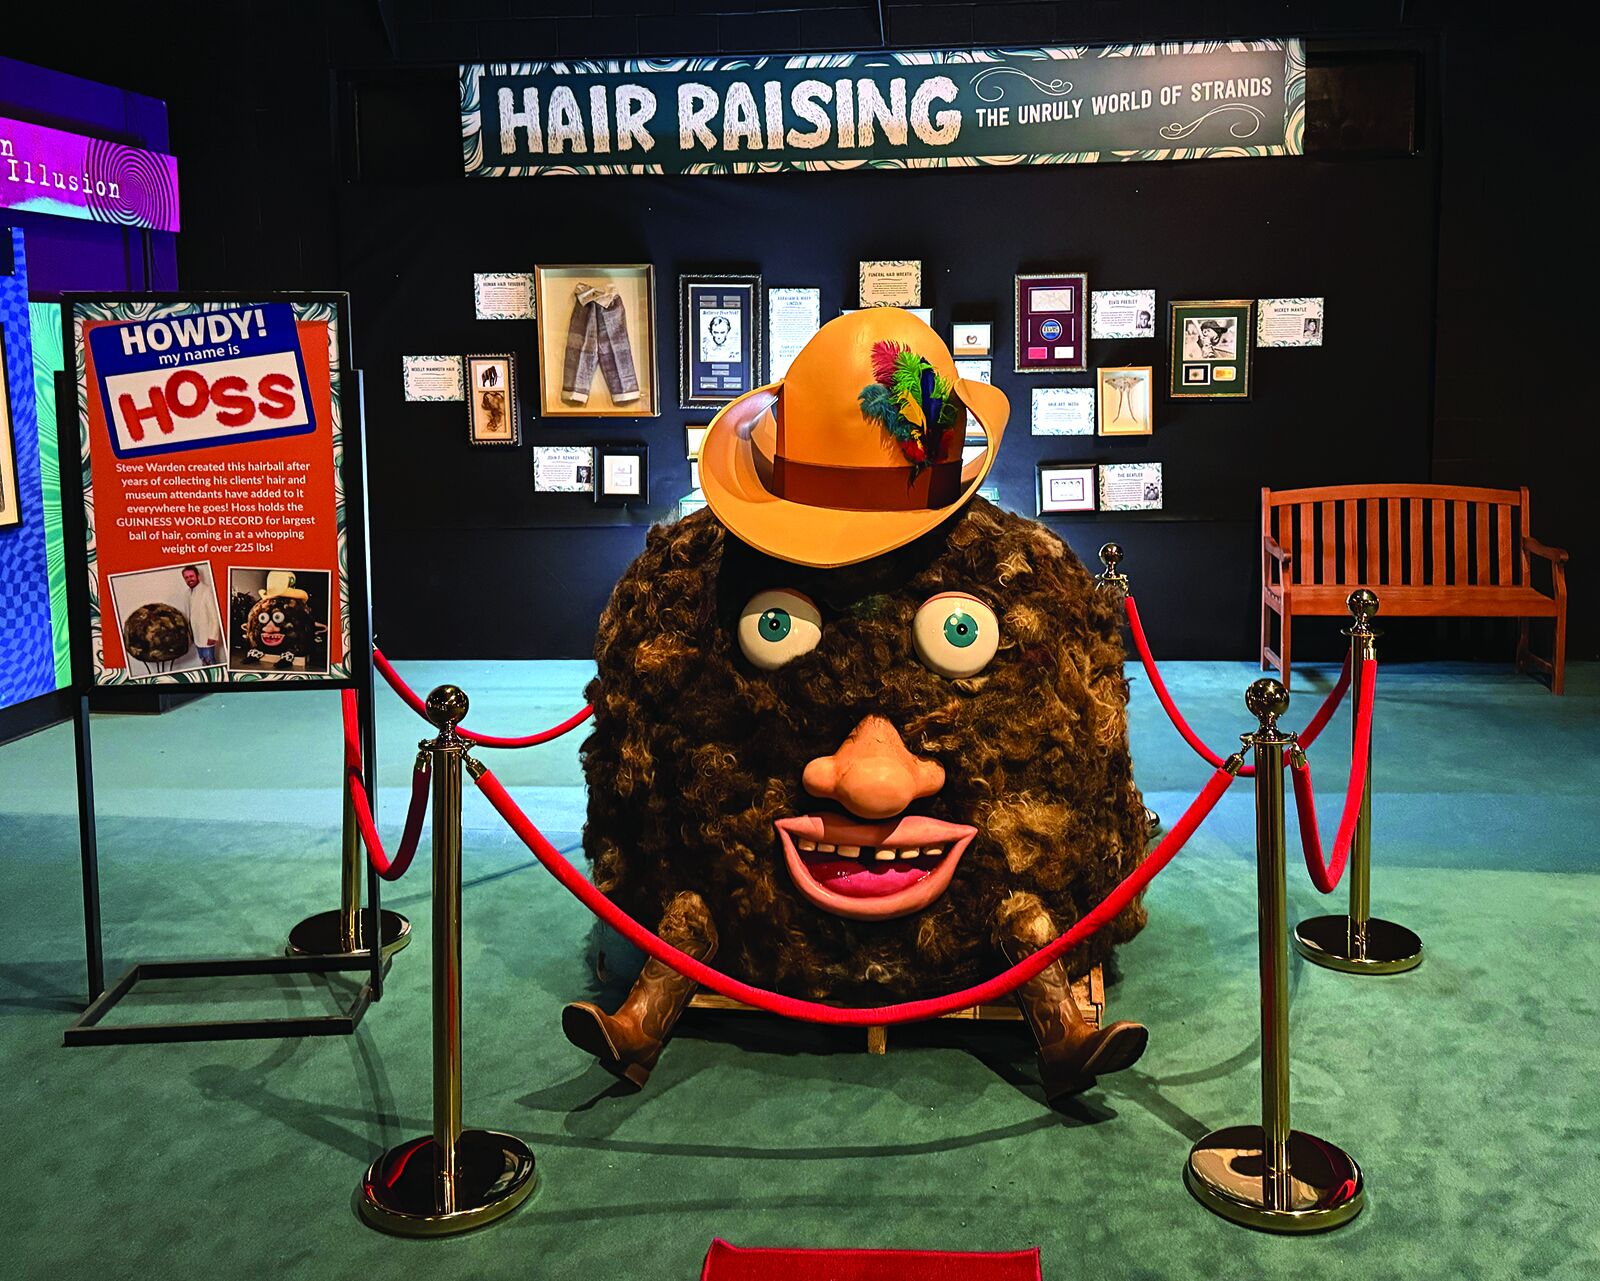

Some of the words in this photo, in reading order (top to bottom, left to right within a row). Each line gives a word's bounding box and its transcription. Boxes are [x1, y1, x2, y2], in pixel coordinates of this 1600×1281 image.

[976, 107, 1009, 128] THE
[1018, 99, 1082, 124] UNRULY
[1092, 89, 1152, 116] WORLD
[1160, 86, 1182, 106] OF
[1191, 77, 1272, 101] STRANDS
[498, 83, 658, 155] HAIR
[677, 76, 962, 152] RAISING
[7, 159, 120, 198] Illusion
[120, 308, 267, 356] HOWDY!
[158, 352, 180, 367] my
[184, 347, 225, 361] name
[228, 344, 240, 355] is
[118, 369, 296, 442] HOSS
[116, 463, 144, 472] Steve
[146, 462, 185, 472] Warden
[188, 462, 224, 472] created
[228, 462, 246, 472] this
[248, 461, 284, 471] hairball
[286, 461, 310, 471] after
[121, 478, 148, 487] years
[150, 476, 161, 486] of
[163, 476, 211, 487] collecting
[213, 475, 228, 485] his
[230, 475, 264, 485] clients'
[266, 475, 285, 484] hair
[288, 475, 306, 484] and
[125, 492, 168, 500] museum
[170, 490, 222, 499] attendants
[224, 489, 248, 498] have
[250, 489, 281, 498] added
[283, 489, 294, 498] to
[296, 488, 304, 498] it
[127, 504, 185, 514] everywhere
[188, 503, 200, 512] he
[203, 503, 228, 514] goes!
[231, 502, 256, 512] Hoss
[258, 502, 284, 512] holds
[287, 502, 304, 511] the
[116, 518, 172, 527] GUINNESS
[174, 517, 216, 526] WORLD
[218, 516, 263, 526] RECORD
[265, 516, 280, 525] for
[282, 516, 316, 526] largest
[129, 531, 146, 540] ball
[149, 531, 160, 540] of
[162, 531, 183, 541] hair,
[185, 530, 221, 541] coming
[224, 530, 233, 539] in
[235, 530, 246, 539] at
[255, 529, 304, 540] whopping
[162, 544, 196, 555] weight
[198, 544, 208, 553] of
[211, 545, 233, 553] over
[234, 543, 254, 552] 225
[256, 543, 274, 552] lbs!
